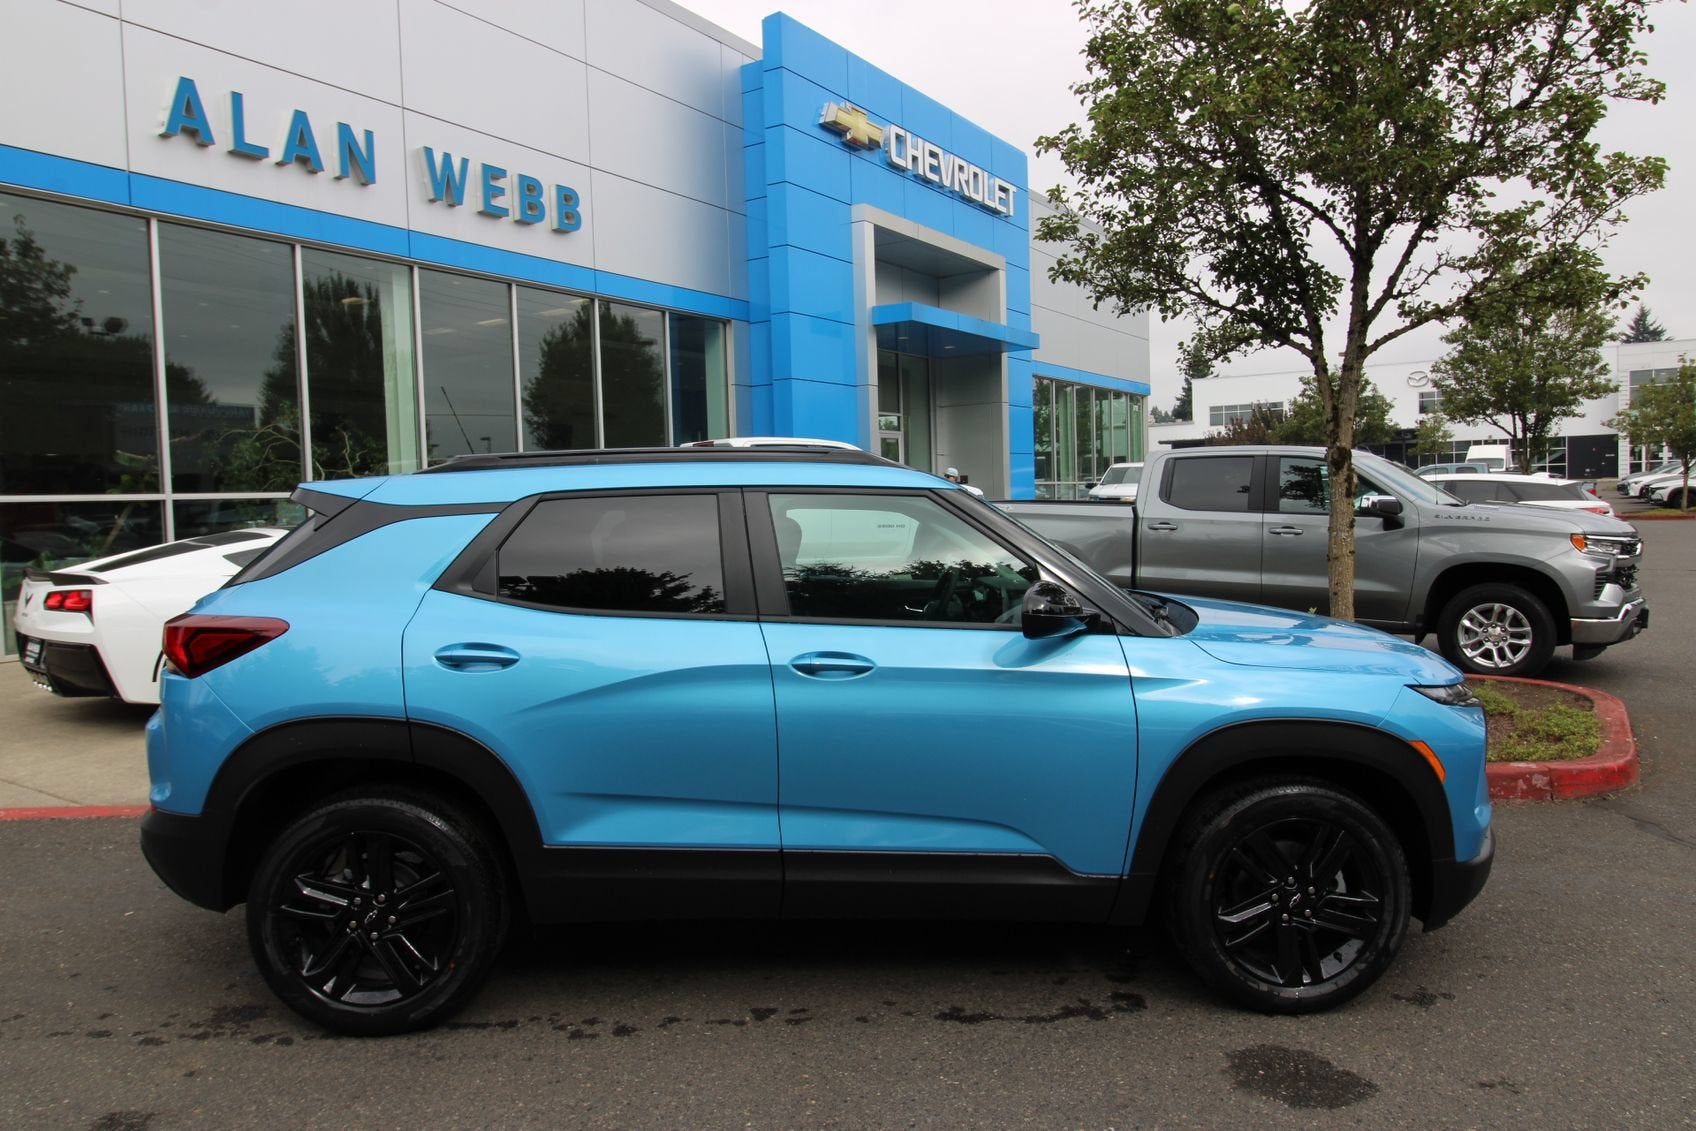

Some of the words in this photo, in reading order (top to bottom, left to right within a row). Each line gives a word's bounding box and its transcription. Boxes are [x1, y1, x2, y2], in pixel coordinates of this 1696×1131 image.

[159, 76, 376, 186] ALAN
[419, 146, 582, 233] WEBB
[889, 124, 1017, 217] CHEVROLET
